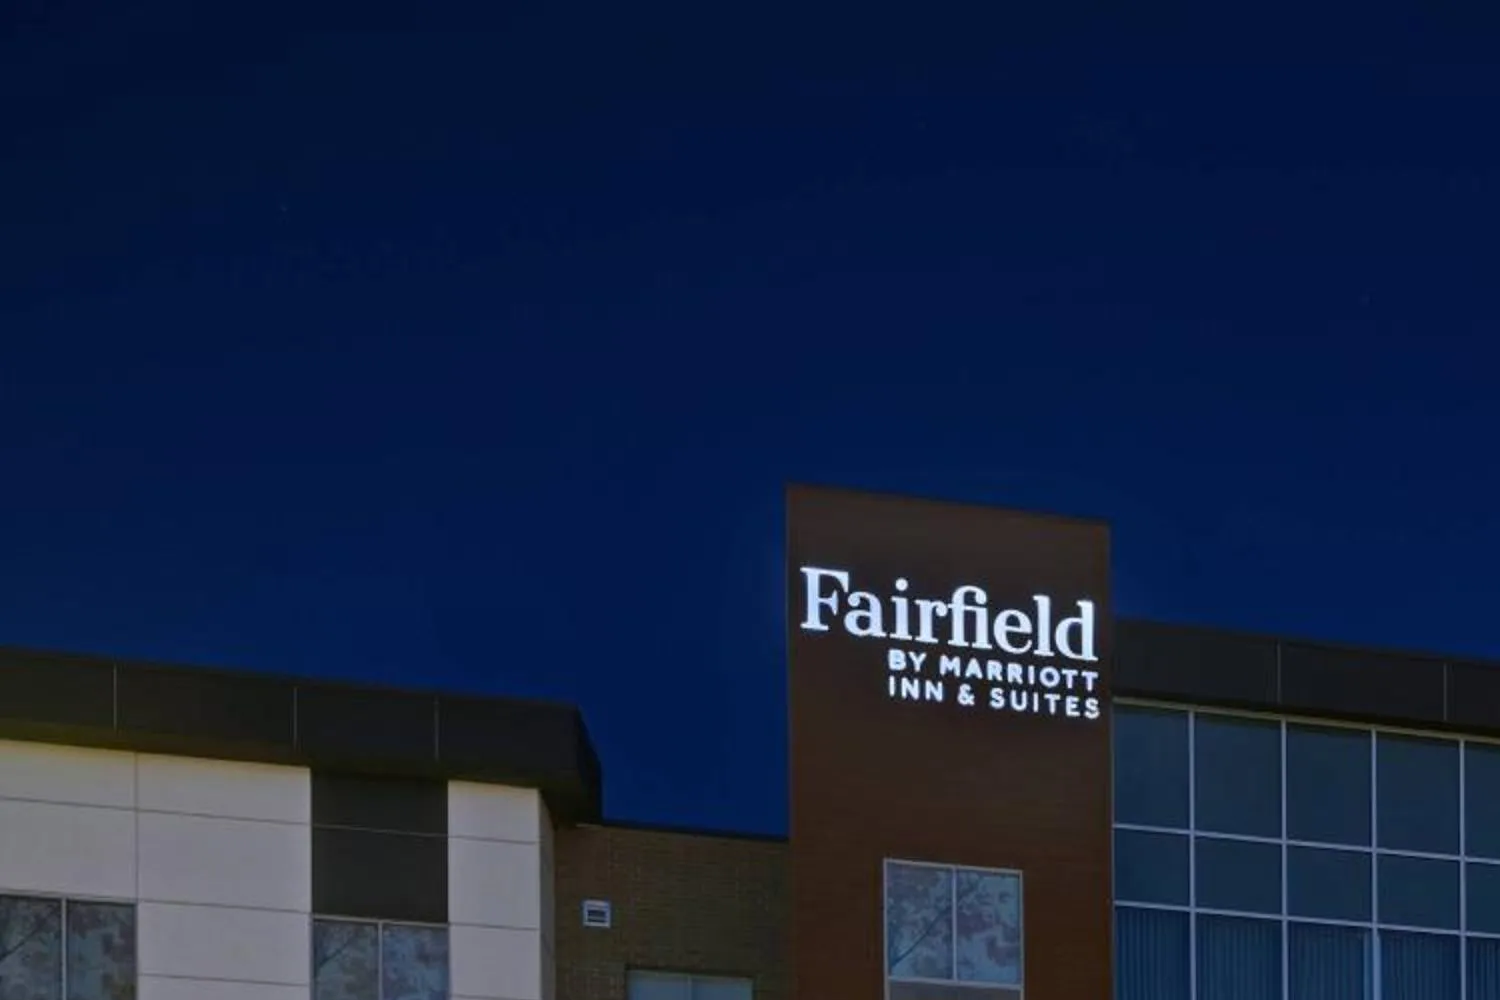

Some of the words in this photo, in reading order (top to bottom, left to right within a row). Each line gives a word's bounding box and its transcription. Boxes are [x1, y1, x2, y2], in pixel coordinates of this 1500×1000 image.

[800, 567, 1099, 662] Fairfield
[888, 649, 927, 672] BY
[939, 654, 1099, 692] MARRIOTT
[888, 675, 944, 702] INN
[957, 684, 975, 706] &
[989, 687, 1100, 719] SUITES
